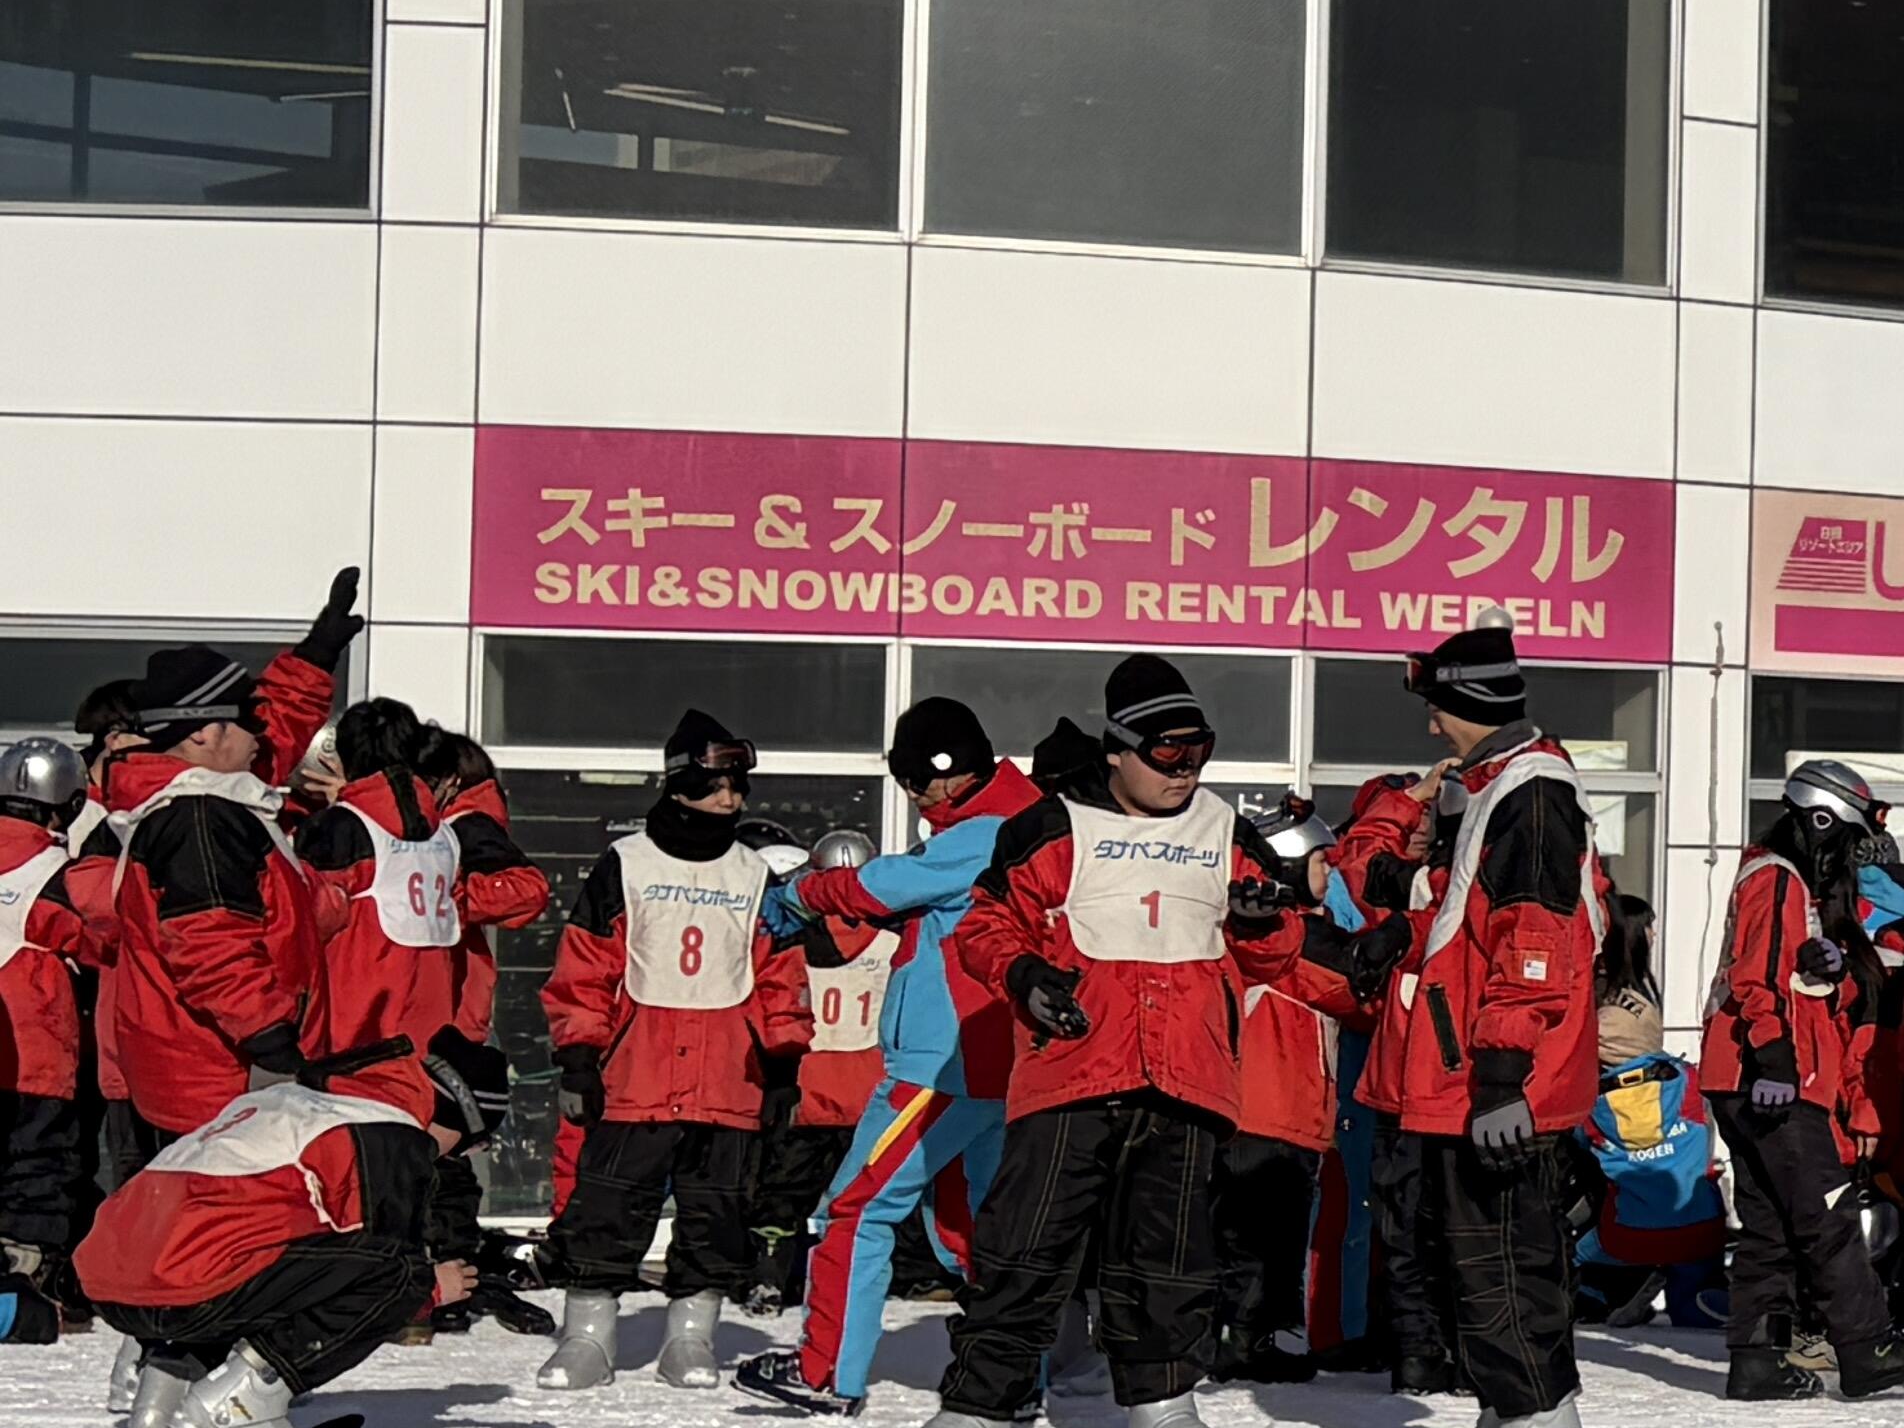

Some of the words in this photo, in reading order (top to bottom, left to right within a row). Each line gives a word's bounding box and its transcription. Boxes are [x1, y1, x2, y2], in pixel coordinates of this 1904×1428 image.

[1247, 476, 1625, 585] レンタル
[533, 561, 1104, 621] SKI&SNOWBOARD
[1123, 582, 1362, 632] RENTAL
[1094, 838, 1220, 869] タナベスポーツ
[407, 871, 447, 918] 62
[1139, 890, 1161, 929] 1
[679, 925, 704, 976] 8
